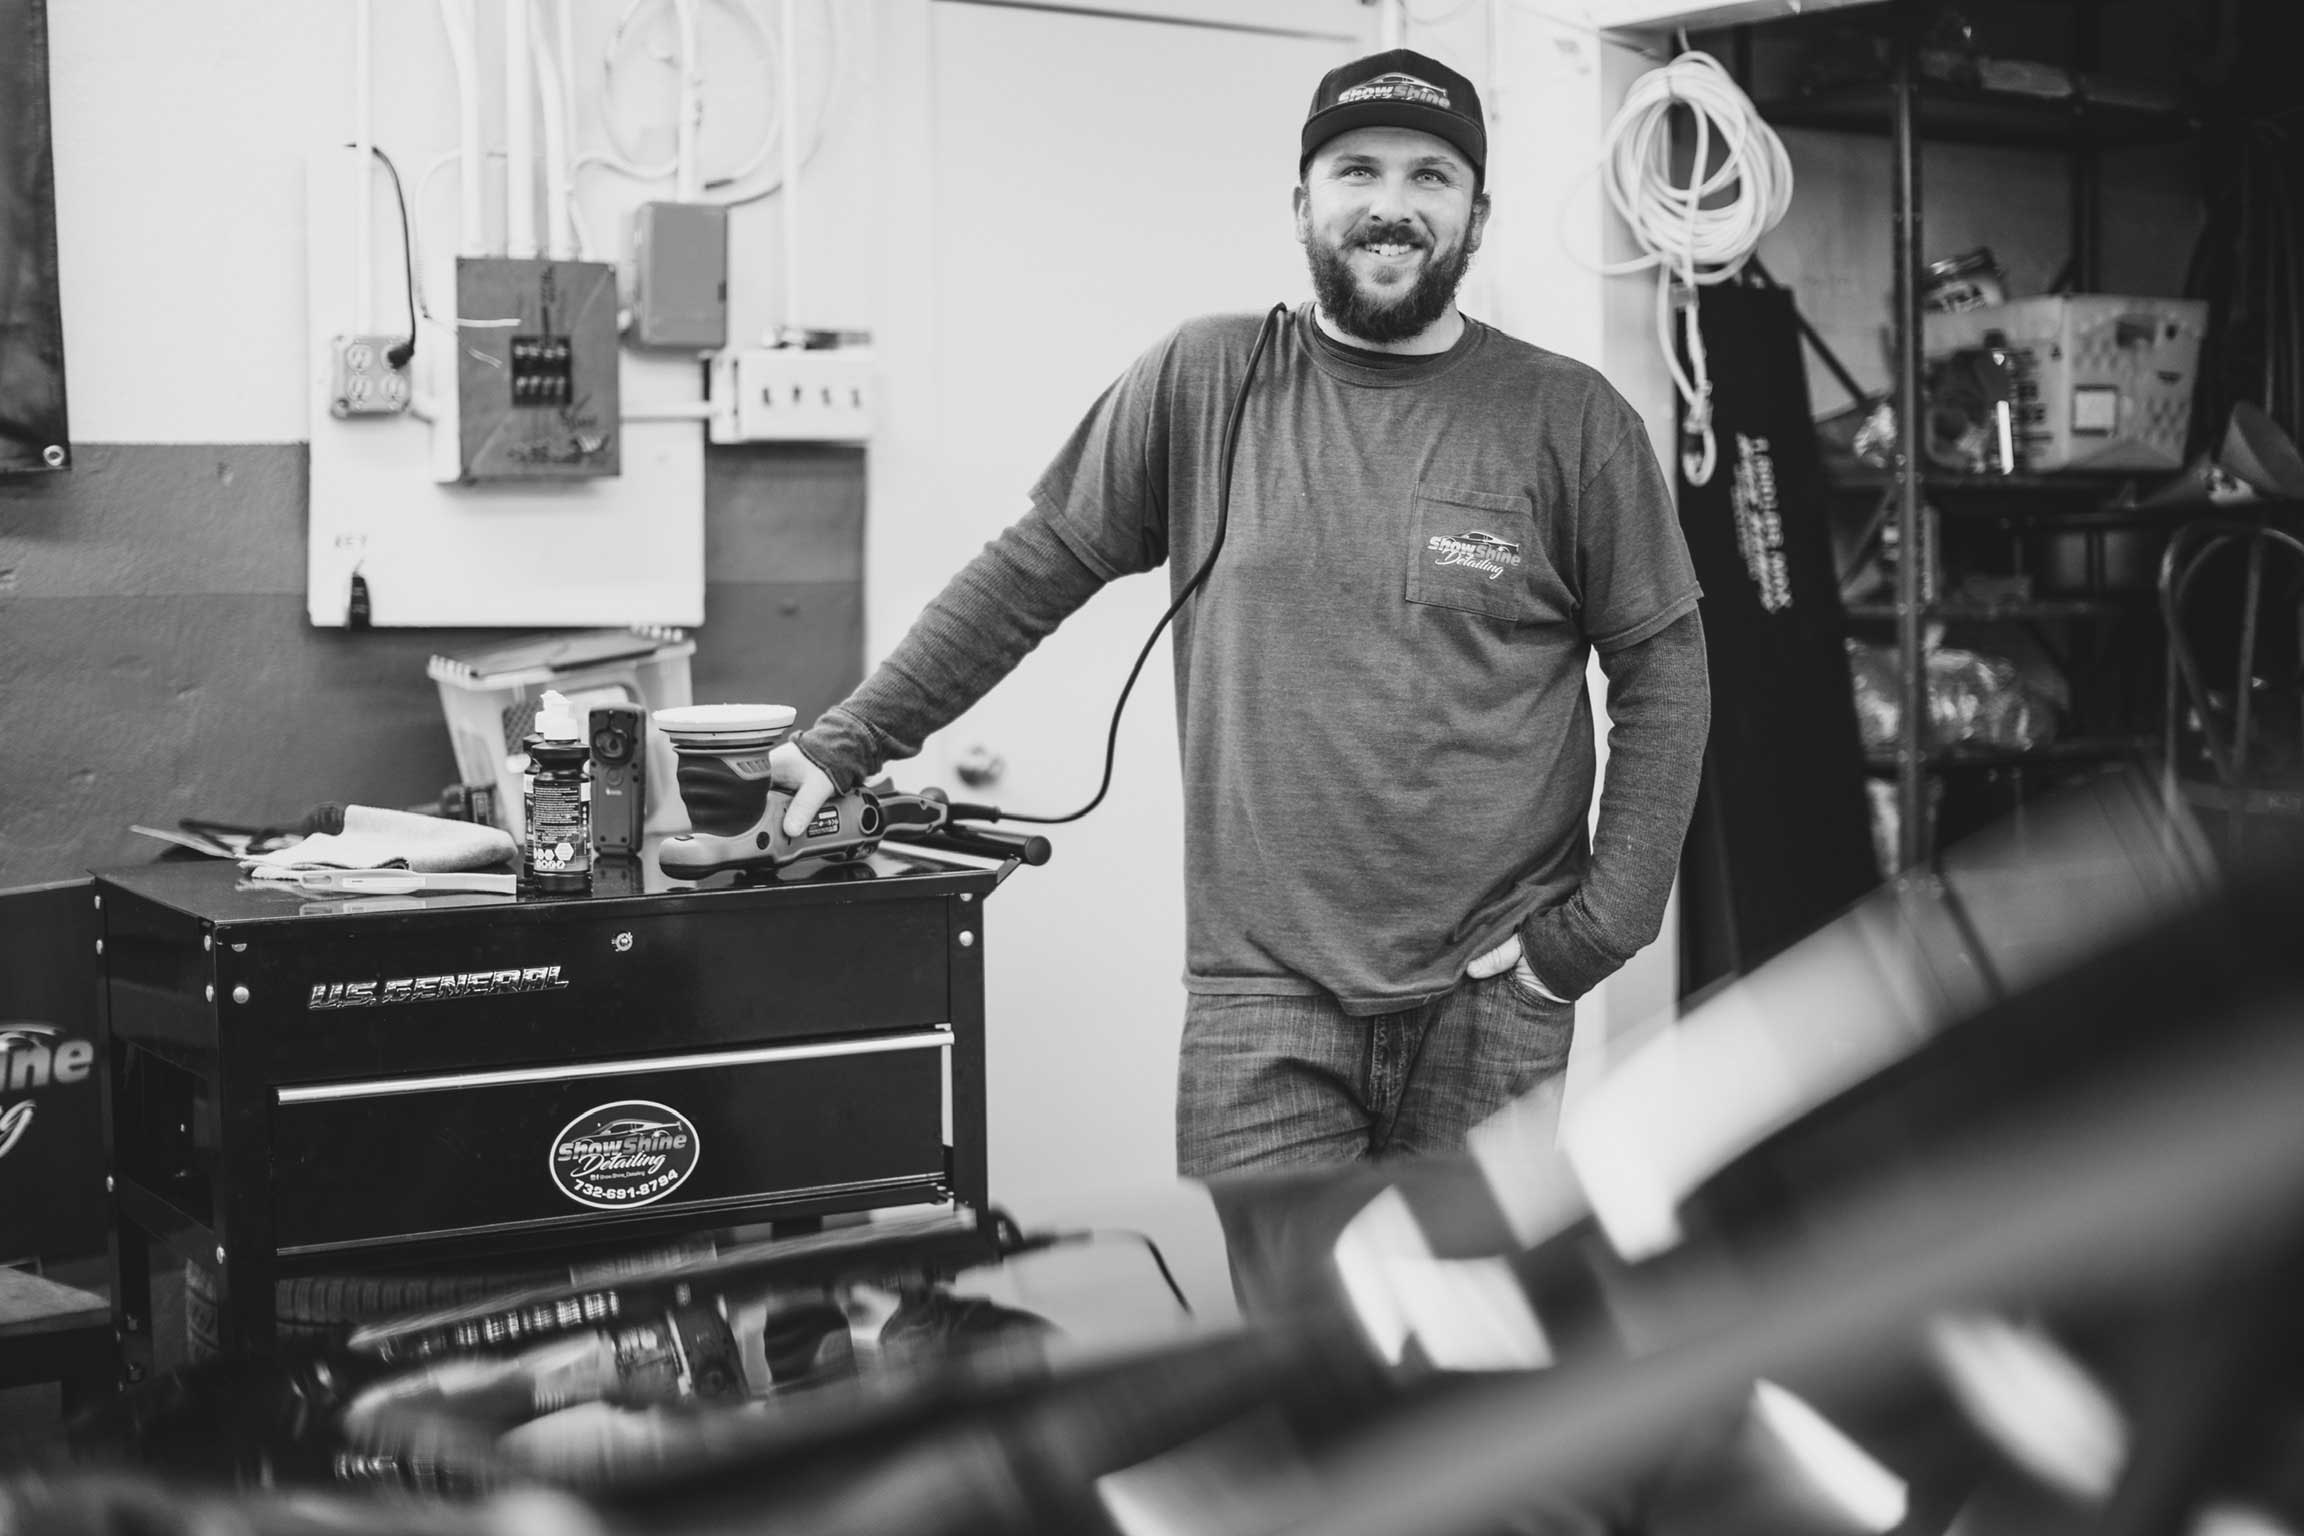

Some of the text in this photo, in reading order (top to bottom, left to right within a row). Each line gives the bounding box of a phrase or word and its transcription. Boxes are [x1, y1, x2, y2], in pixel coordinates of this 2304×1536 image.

[1434, 549, 1504, 580] Detailing
[570, 1151, 667, 1178] Detailing
[574, 1169, 679, 1200] 732-691-8794
